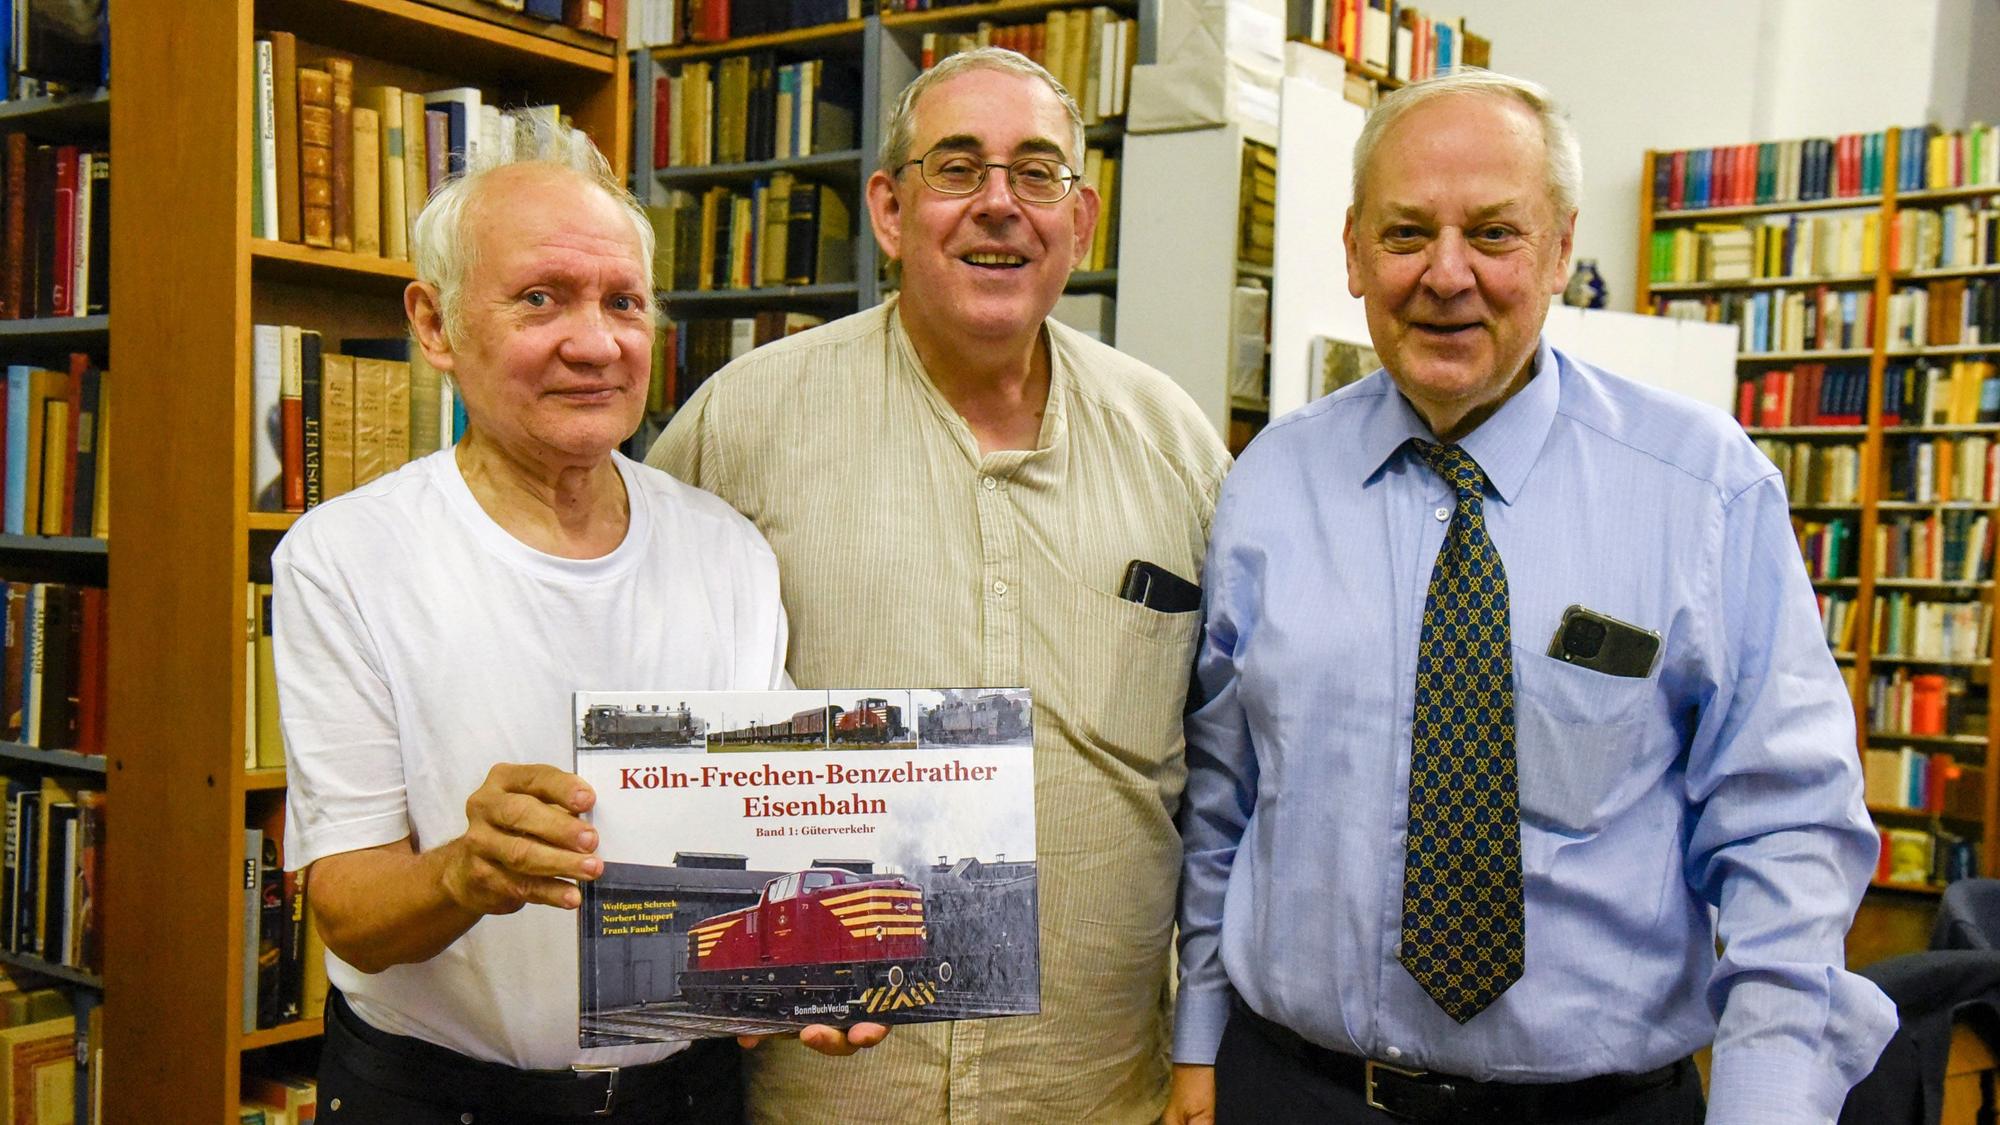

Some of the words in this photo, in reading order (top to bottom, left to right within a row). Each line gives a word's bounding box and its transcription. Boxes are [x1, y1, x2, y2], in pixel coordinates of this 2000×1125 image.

[306, 417, 320, 511] ROOSEVELT
[620, 760, 998, 790] Köln-Frechen-Benzelrather
[743, 793, 888, 818] Eisenbahn
[755, 827, 785, 837] Band
[789, 826, 798, 836] 1:
[801, 824, 876, 837] Güterverkehr
[602, 902, 643, 911] Wolfgang
[643, 900, 677, 909] Schreck
[602, 914, 636, 923] Norbert
[638, 912, 673, 922] Huppert
[602, 926, 629, 935] Frank
[630, 924, 659, 934] Faubel
[794, 1003, 850, 1016] BonnBuchVerlag
